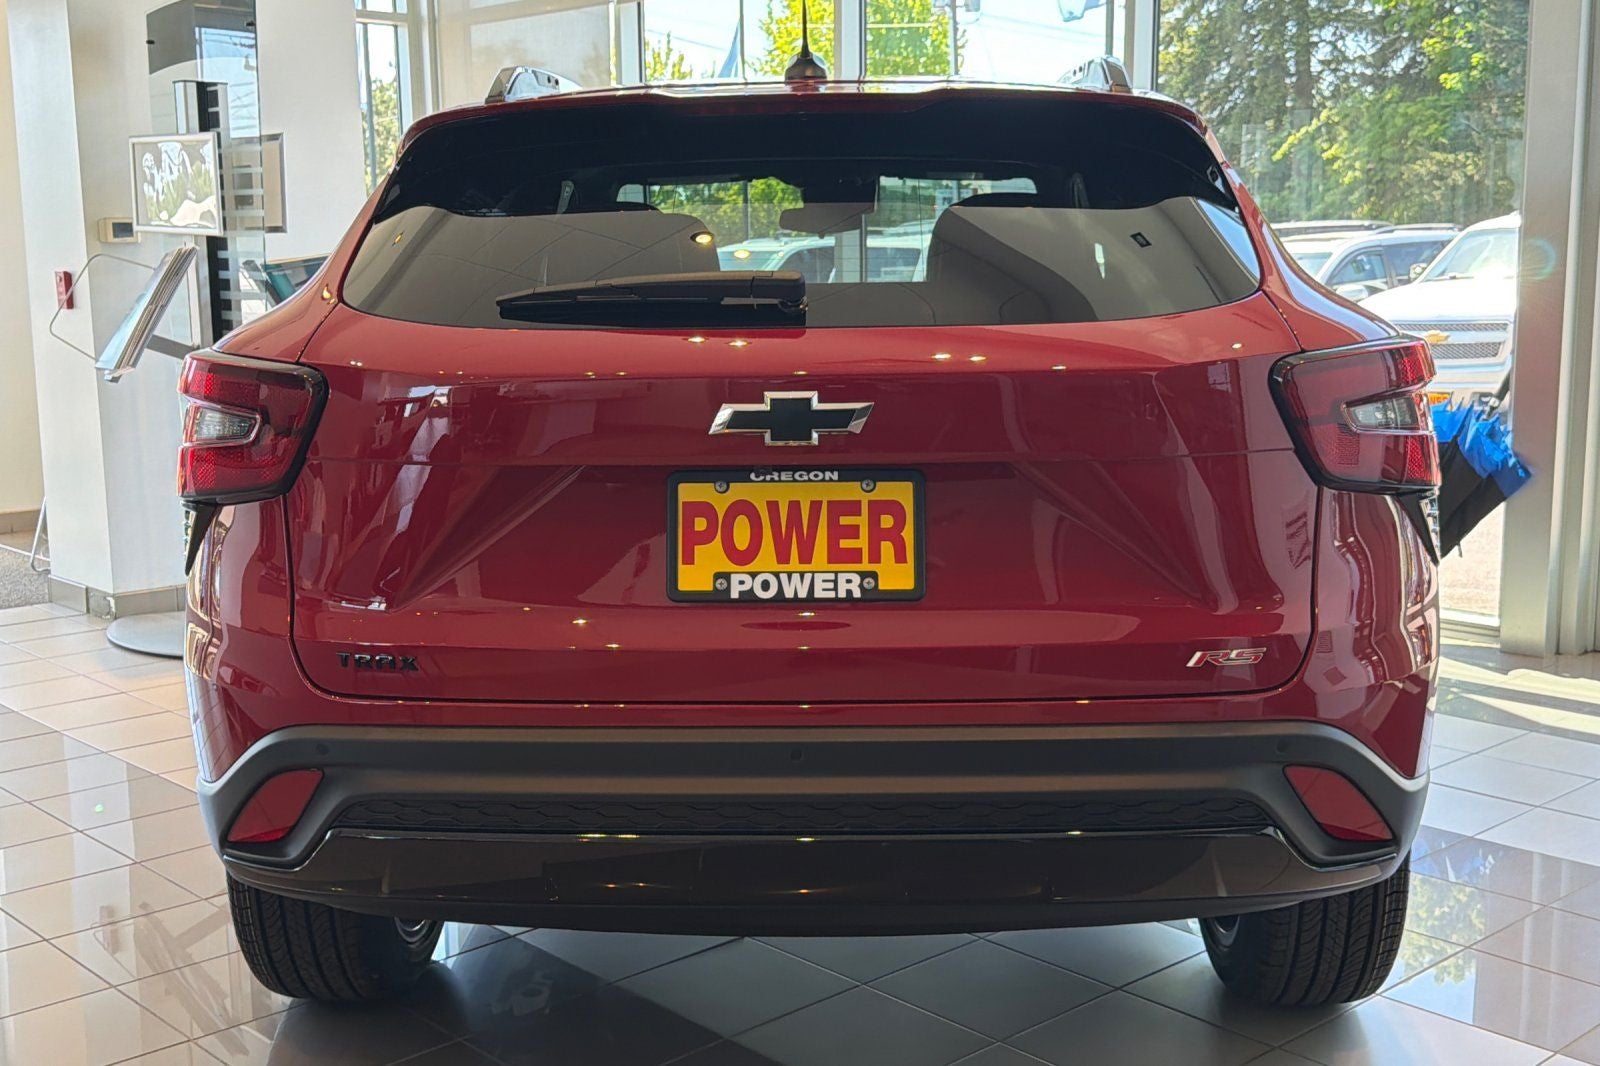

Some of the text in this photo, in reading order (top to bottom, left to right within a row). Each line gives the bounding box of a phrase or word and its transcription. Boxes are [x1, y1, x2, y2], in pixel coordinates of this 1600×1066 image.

[749, 471, 839, 481] OREGON
[681, 498, 908, 566] POWER
[730, 572, 862, 599] POWER
[1185, 647, 1267, 668] RS
